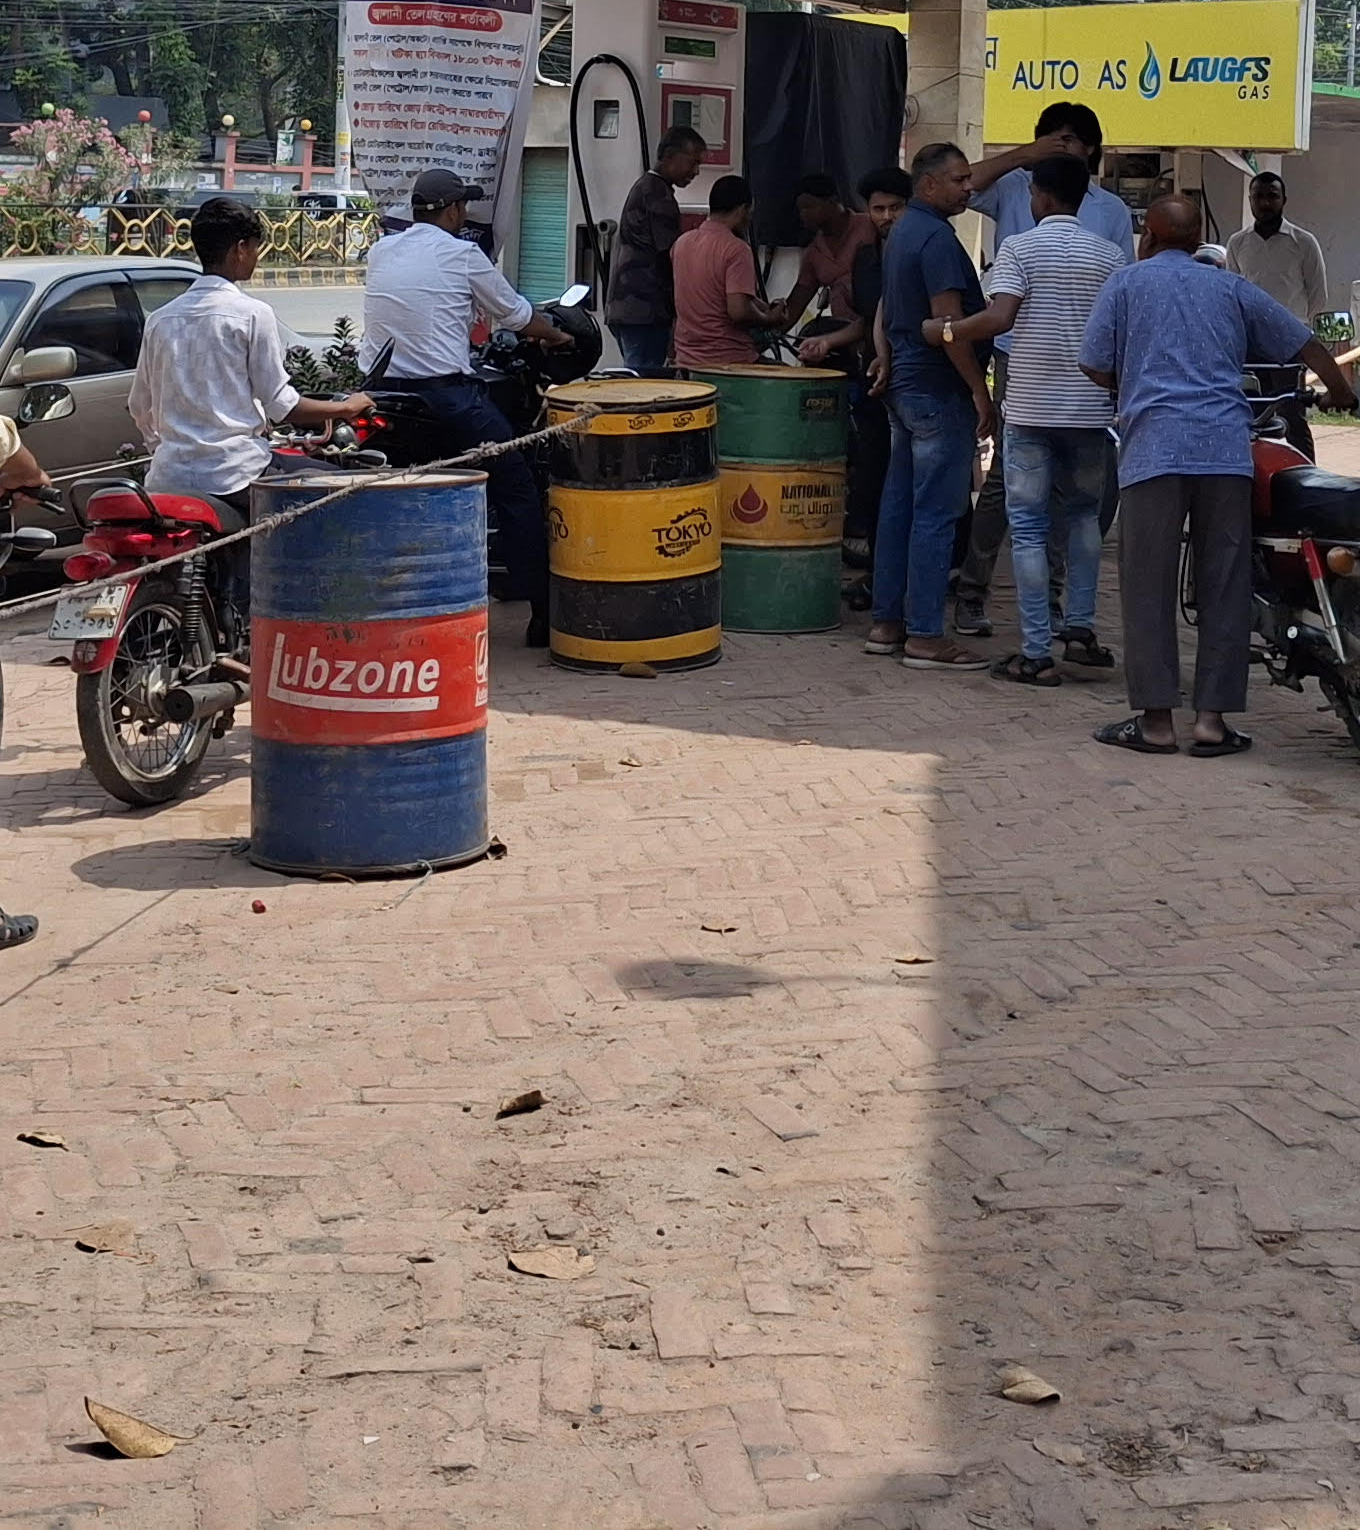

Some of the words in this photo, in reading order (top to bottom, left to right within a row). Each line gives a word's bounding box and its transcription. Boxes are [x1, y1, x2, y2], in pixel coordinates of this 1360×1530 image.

[1011, 59, 1080, 91] AUTO
[1168, 56, 1272, 83] LAUGFS
[1237, 84, 1271, 101] GAS
[651, 521, 712, 543] TOKYO
[267, 632, 440, 713] Lubzone
